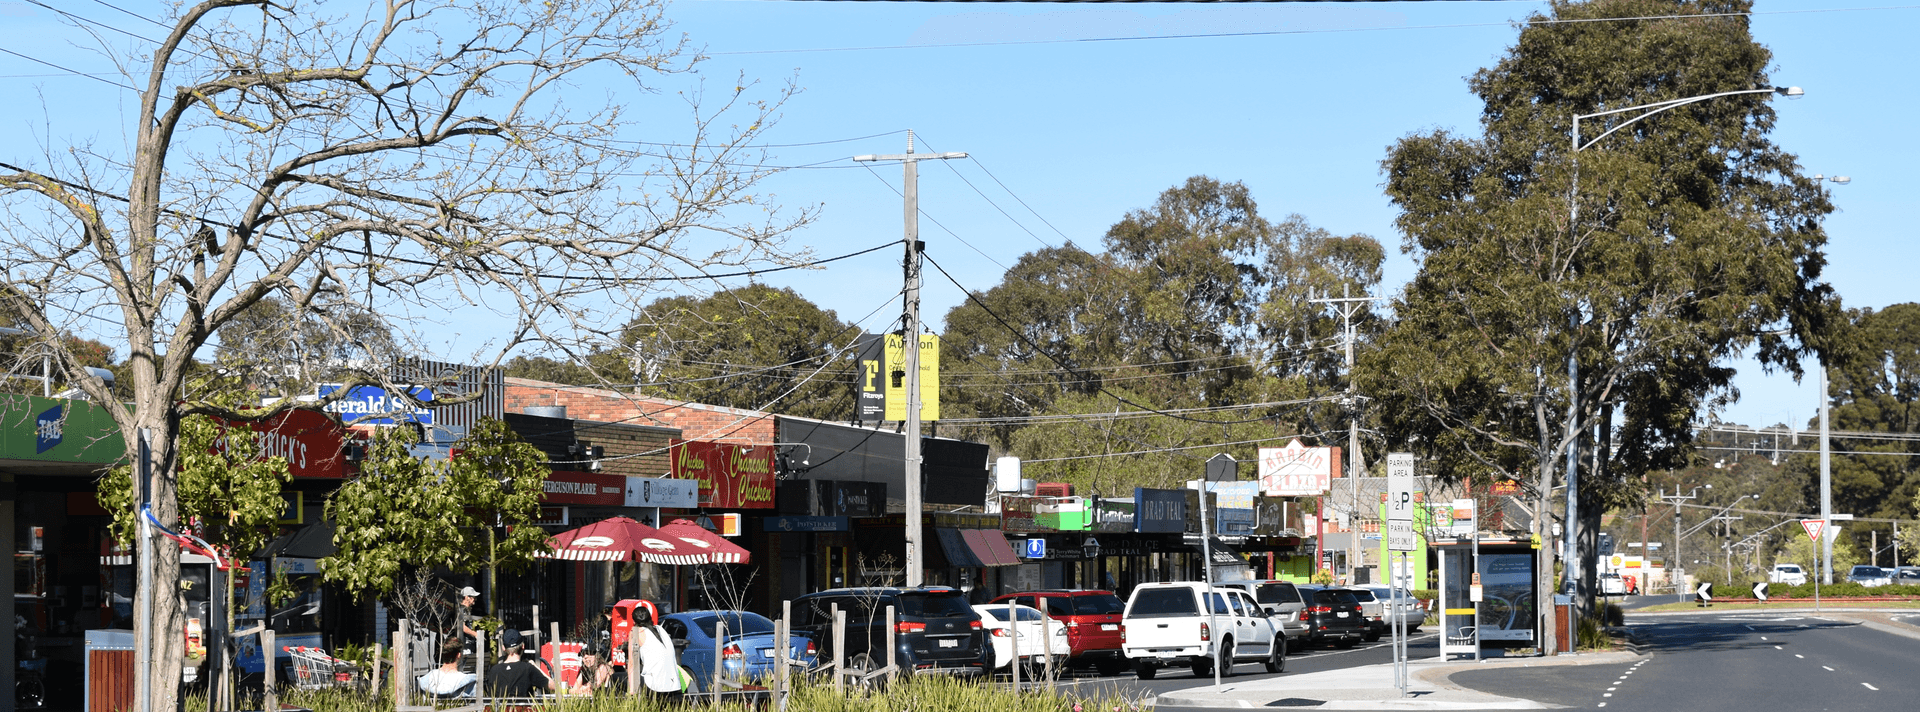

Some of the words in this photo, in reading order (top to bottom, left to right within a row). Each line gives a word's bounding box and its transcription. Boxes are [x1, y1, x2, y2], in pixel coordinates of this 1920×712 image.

[889, 339, 933, 349] Auon
[863, 392, 884, 400] Fitzroys
[39, 420, 62, 440] TAB
[730, 445, 770, 478] Charcoal
[1265, 449, 1323, 469] ARABIN
[1389, 459, 1412, 467] PARKING
[1393, 469, 1408, 477] AREA
[543, 480, 574, 494] FERGUSON
[574, 482, 597, 495] PLARRE
[738, 474, 772, 507] Chicken
[1271, 475, 1318, 491] PLAZA
[1144, 500, 1164, 520] BRAD
[1166, 501, 1182, 521] TEAL
[1390, 524, 1403, 532] PARK
[1389, 536, 1400, 545] BAYS
[1401, 537, 1411, 546] ONLY
